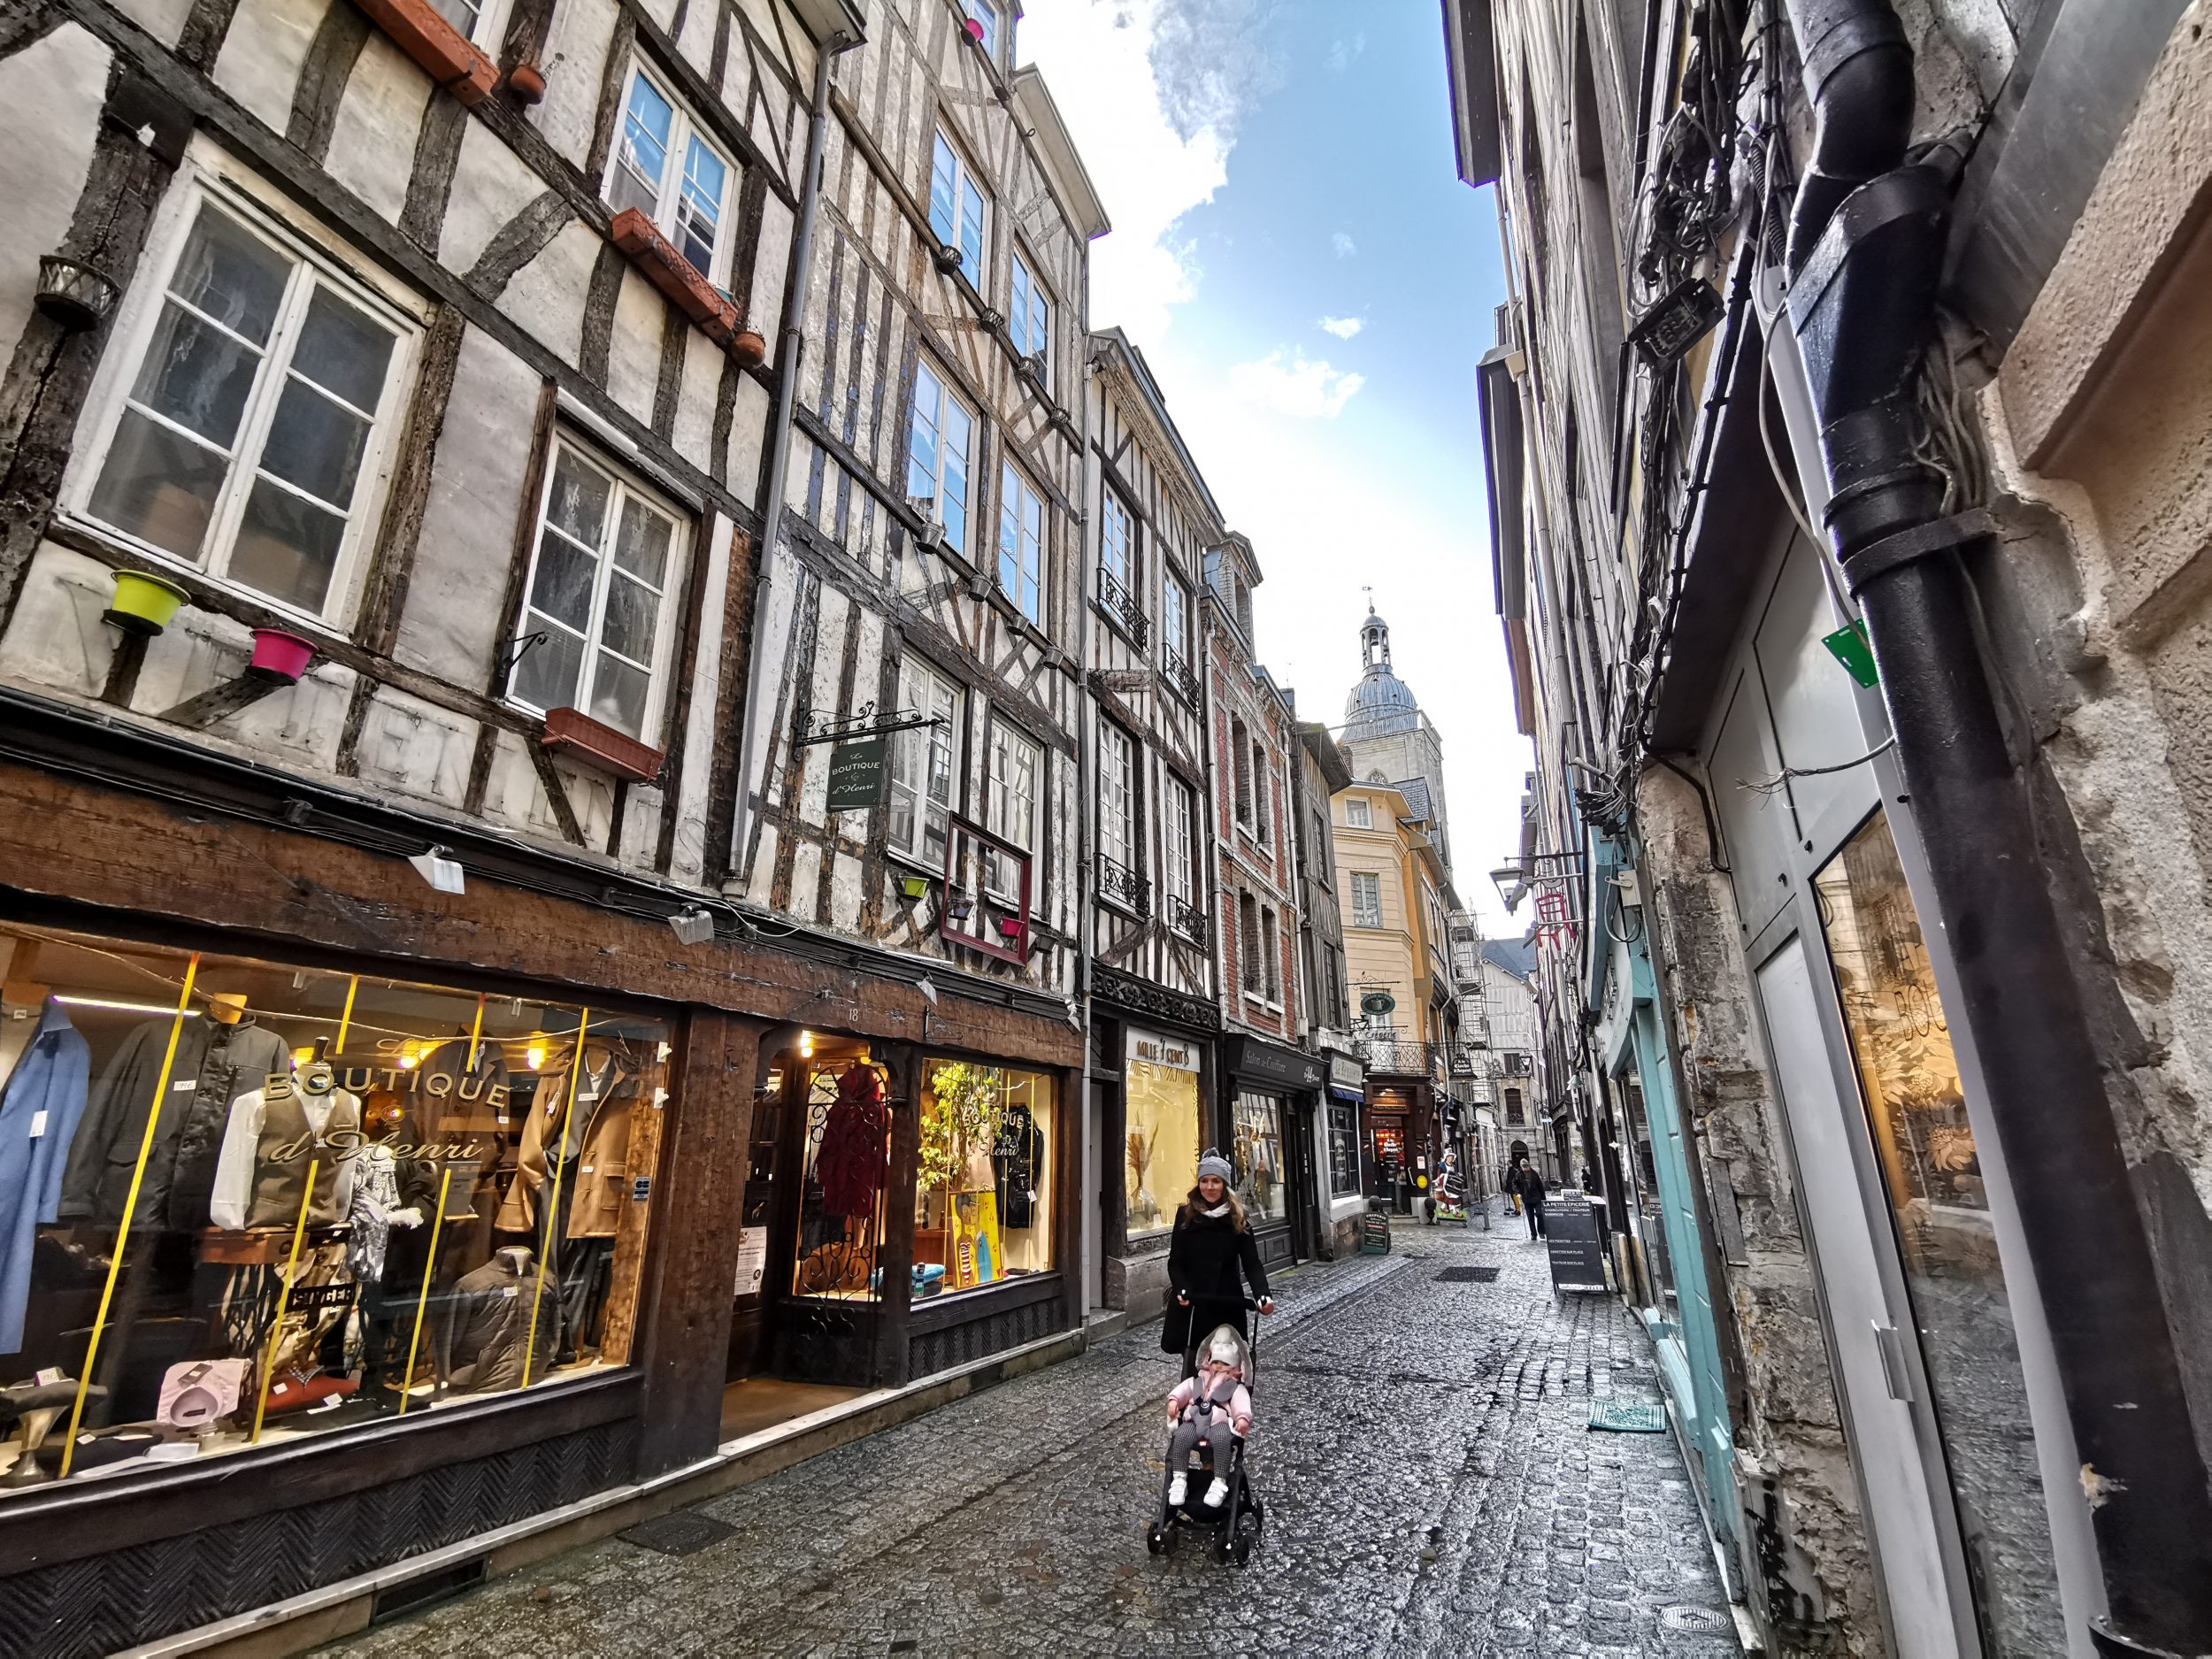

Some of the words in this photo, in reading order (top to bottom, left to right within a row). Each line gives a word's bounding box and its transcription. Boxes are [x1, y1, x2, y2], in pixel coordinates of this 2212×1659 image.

[832, 762, 880, 776] BOUTIQUE
[832, 783, 876, 795] d'Henri
[849, 1008, 858, 1022] 18
[265, 1067, 511, 1109] BOUTIQUE
[964, 1111, 1025, 1129] BOUTIQUE
[268, 1129, 484, 1163] d'Henri
